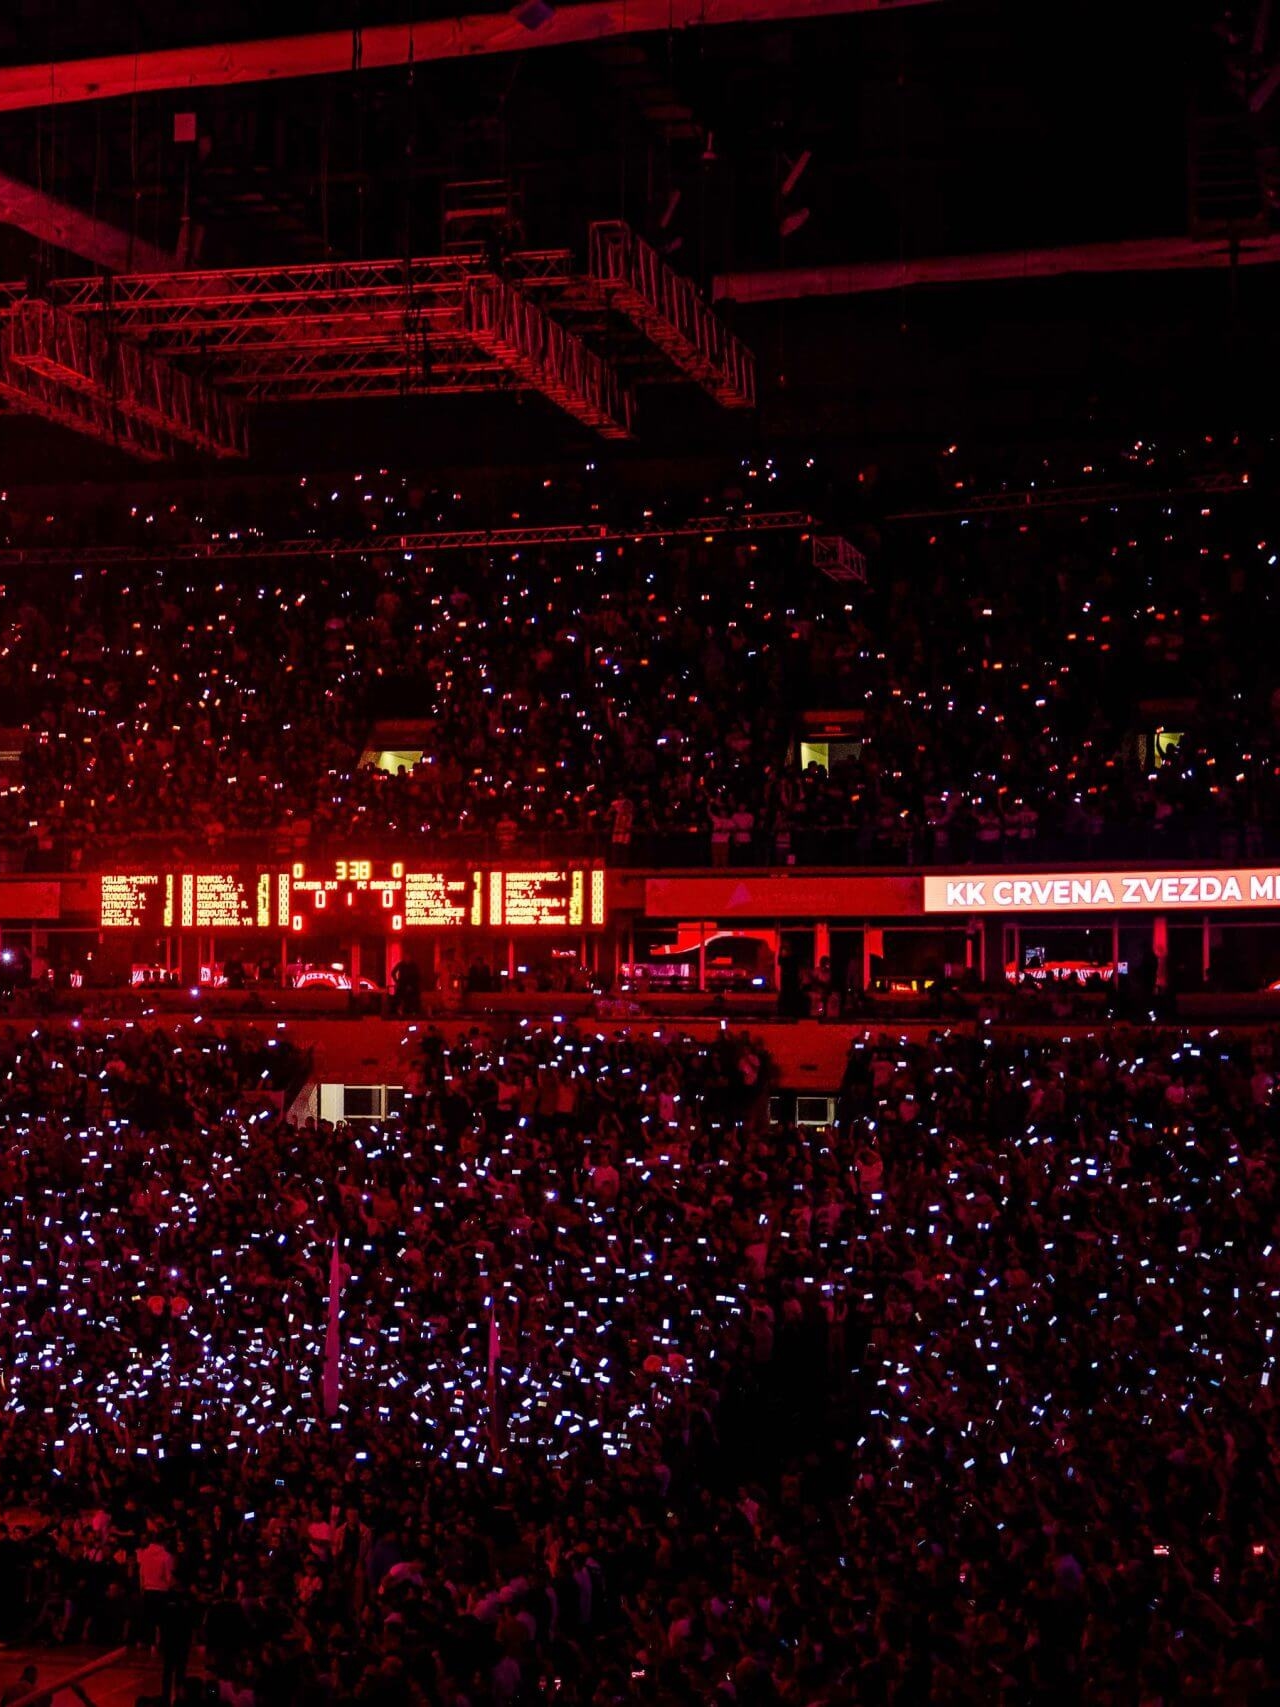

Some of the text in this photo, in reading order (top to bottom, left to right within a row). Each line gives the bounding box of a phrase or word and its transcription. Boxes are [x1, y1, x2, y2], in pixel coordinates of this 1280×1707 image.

[293, 863, 304, 879] 0
[392, 862, 403, 878] 0
[947, 875, 1280, 905] KK CRVENA ZVEZDA M
[315, 890, 326, 908] 0
[382, 890, 393, 908] 0
[293, 915, 402, 931] 0 0
